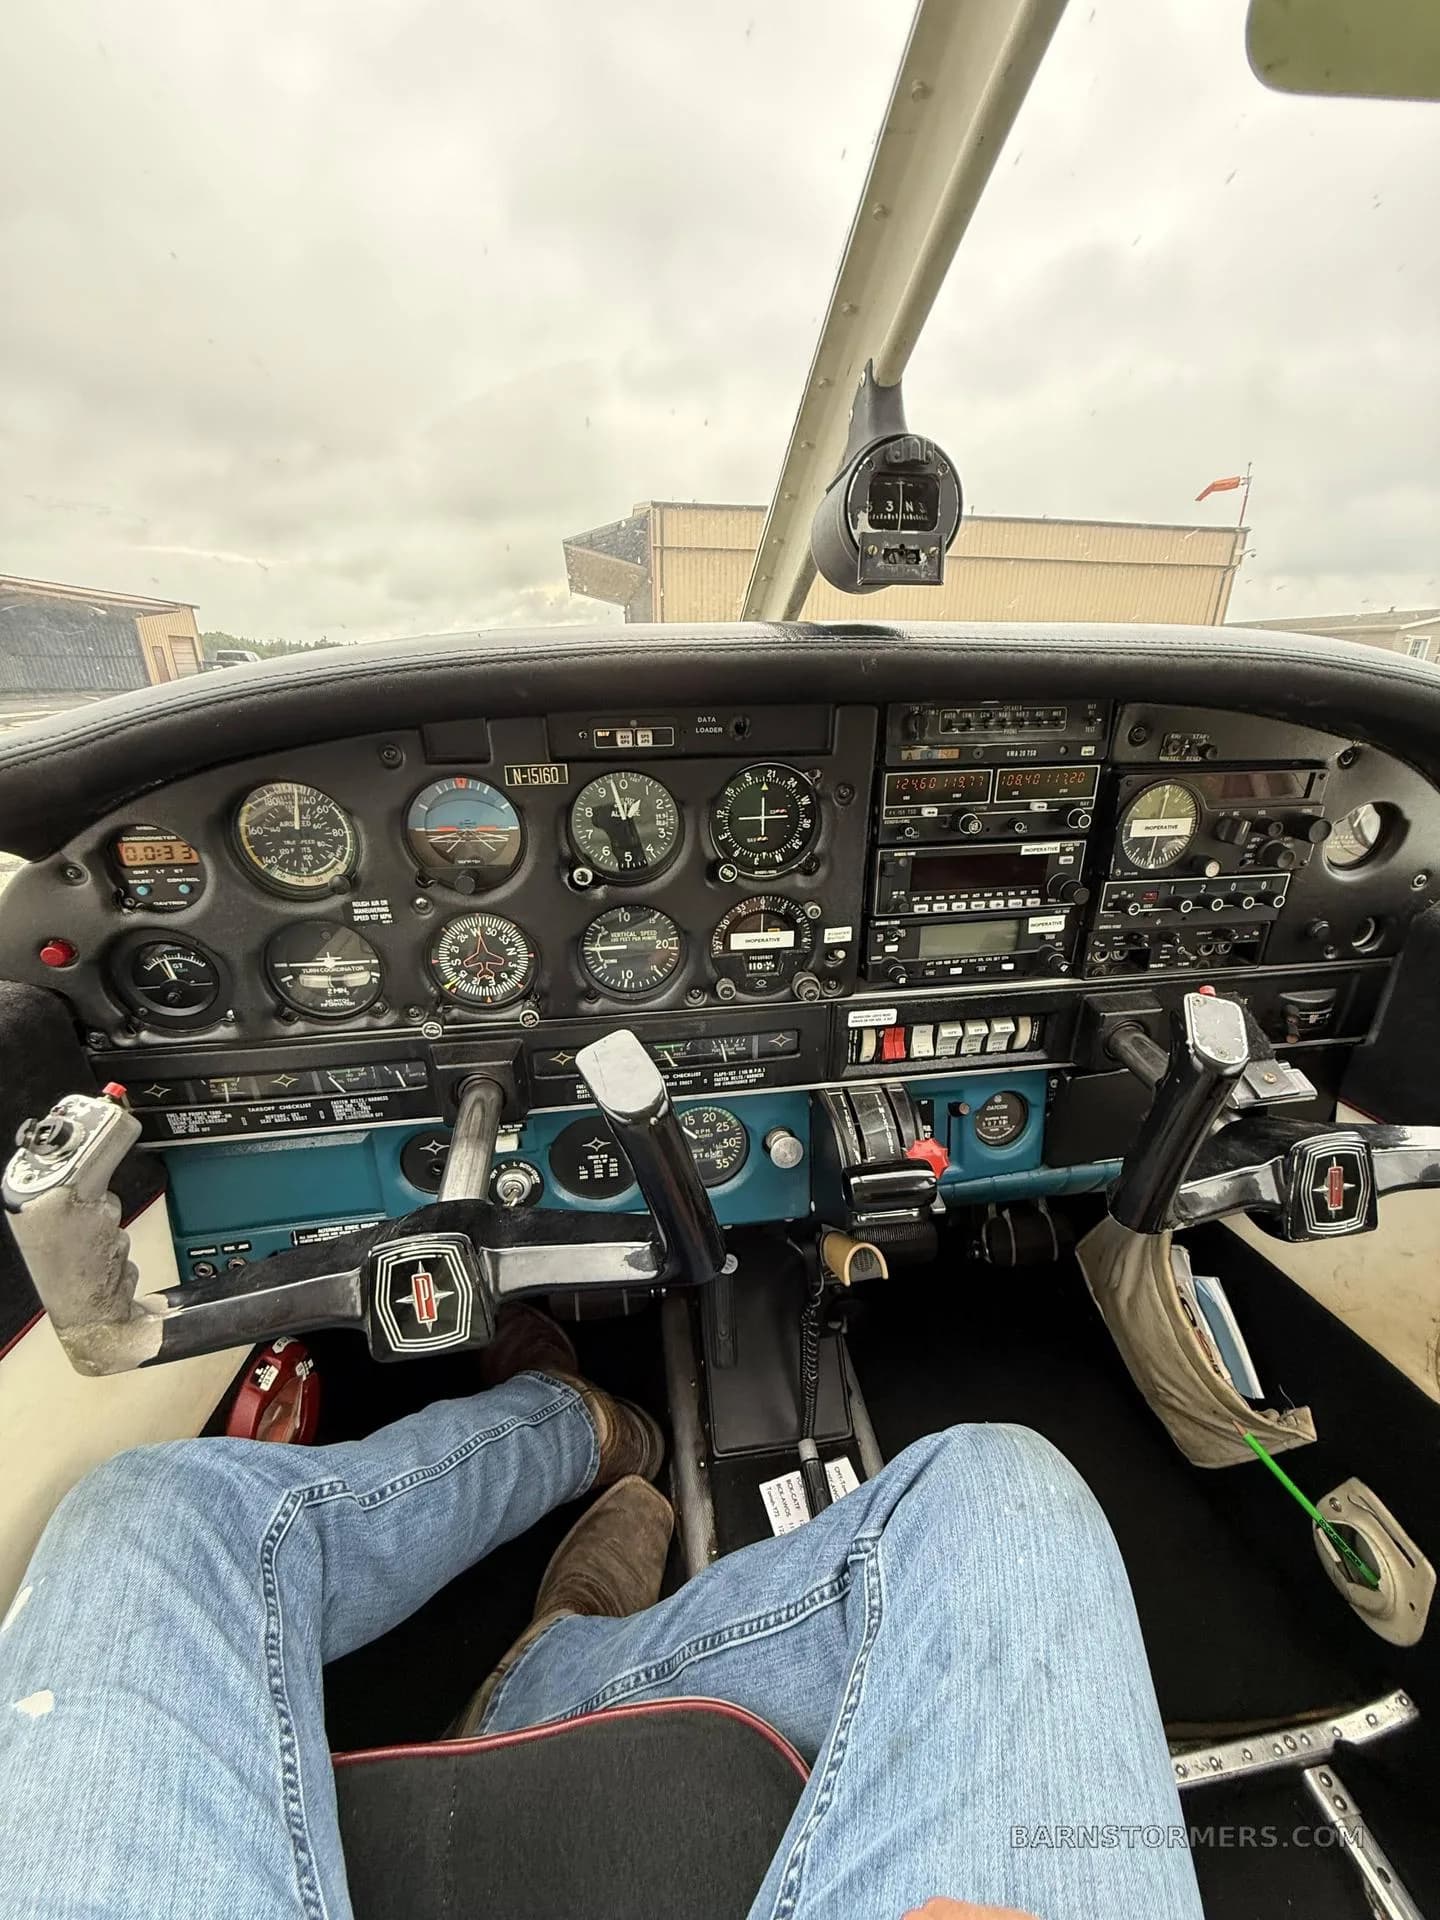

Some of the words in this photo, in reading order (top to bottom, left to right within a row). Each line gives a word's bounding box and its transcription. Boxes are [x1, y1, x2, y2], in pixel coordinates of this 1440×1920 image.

[885, 501, 894, 512] 3
[906, 501, 914, 512] N
[512, 767, 559, 784] N-15160
[744, 772, 752, 782] S
[767, 769, 777, 778] 21
[619, 779, 628, 790] 0
[787, 777, 798, 788] 24
[598, 787, 606, 797] 9
[645, 785, 649, 796] 1
[303, 796, 316, 805] 40
[655, 799, 664, 809] 2
[316, 805, 329, 814] 60
[585, 807, 594, 817] 8
[248, 826, 264, 836] 160
[331, 829, 345, 838] 80
[586, 829, 594, 839] 7
[658, 828, 666, 838] 3
[602, 846, 611, 856] 6
[262, 855, 278, 865] 140
[624, 852, 633, 862] 5
[618, 912, 631, 922] 10
[655, 939, 669, 949] 20
[320, 965, 365, 973] COORDINATOR
[621, 969, 634, 979] 10
[279, 1102, 312, 1110] CHECKLIST
[684, 1115, 695, 1126] 15
[703, 1112, 717, 1123] 20
[715, 1121, 730, 1132] 25
[722, 1137, 736, 1148] 30
[715, 1158, 730, 1169] 35
